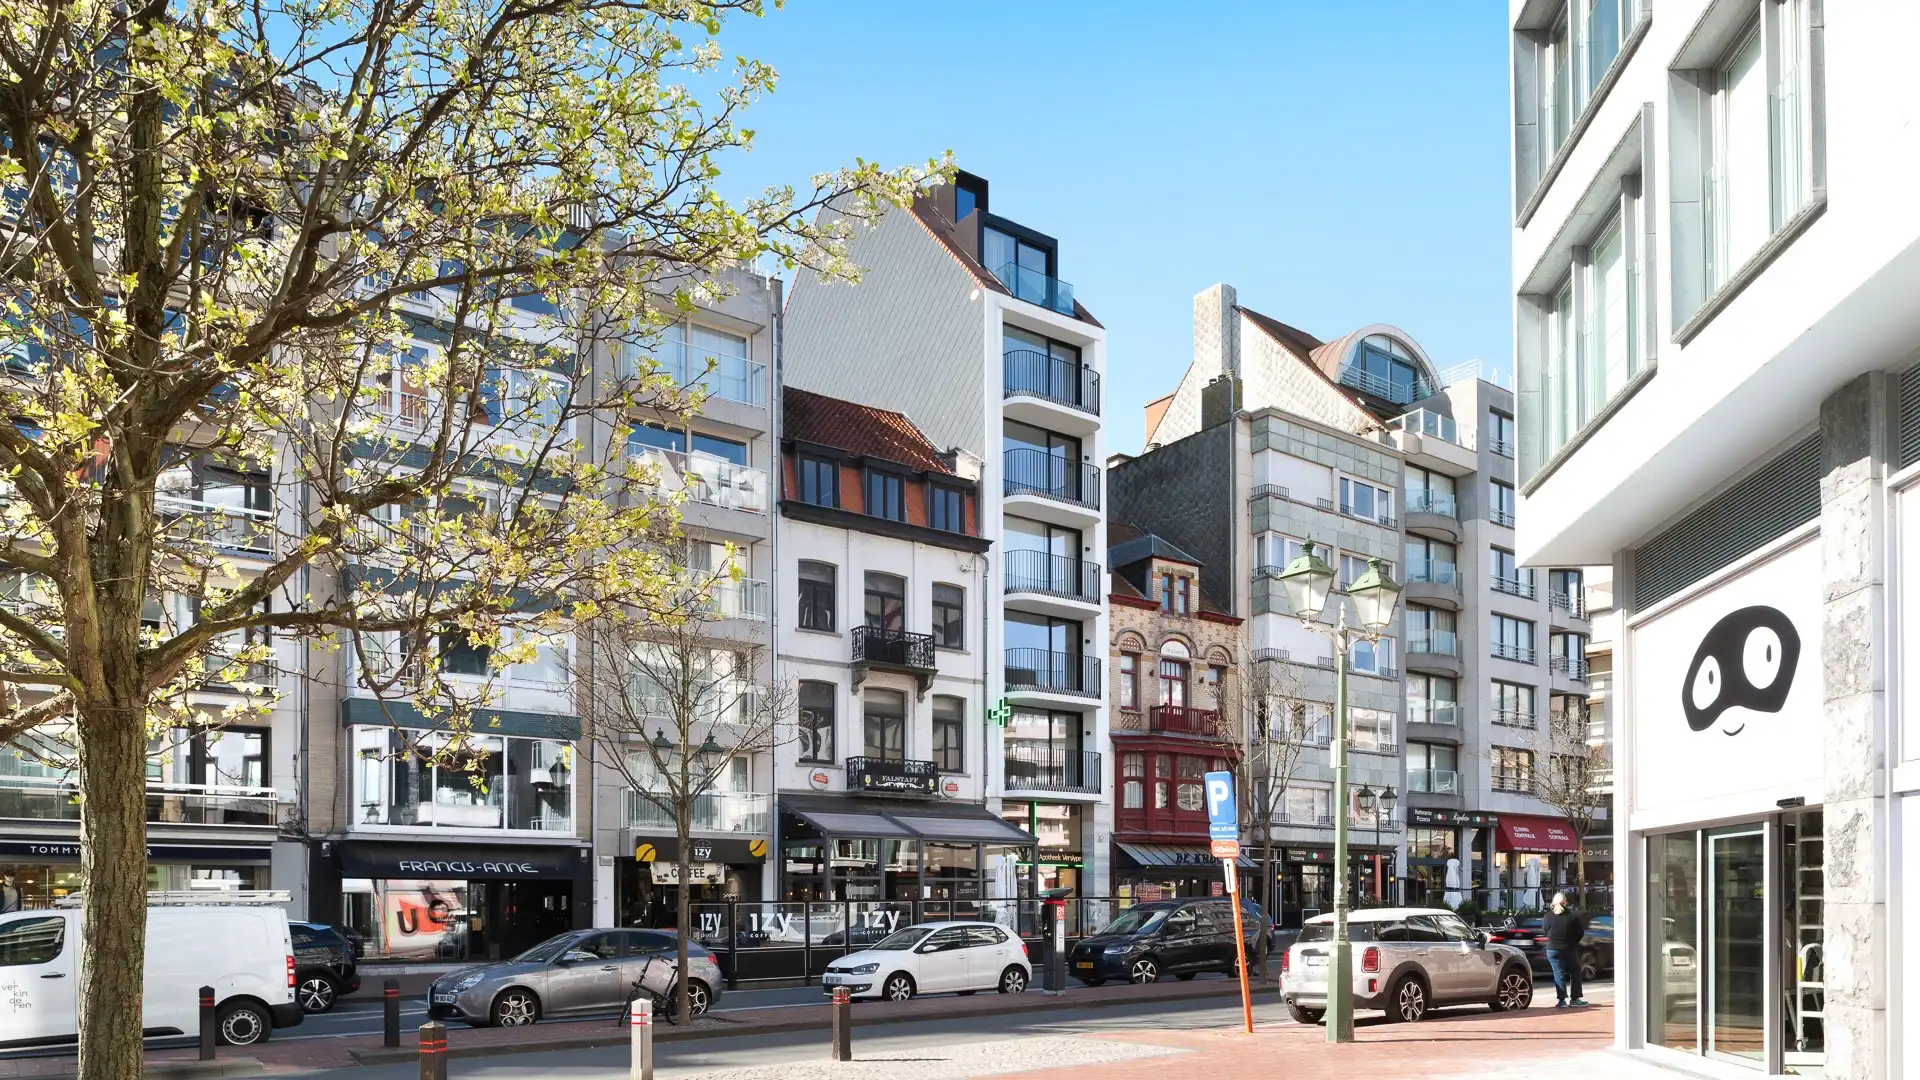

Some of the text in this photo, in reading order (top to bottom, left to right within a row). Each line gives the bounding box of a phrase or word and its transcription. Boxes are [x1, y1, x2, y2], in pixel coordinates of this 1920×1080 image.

[882, 775, 919, 783] FALSTAFF
[1208, 780, 1229, 816] P
[30, 846, 80, 854] TOMMY
[399, 860, 538, 872] FRANCIS-ANNE
[671, 868, 706, 878] CFEE
